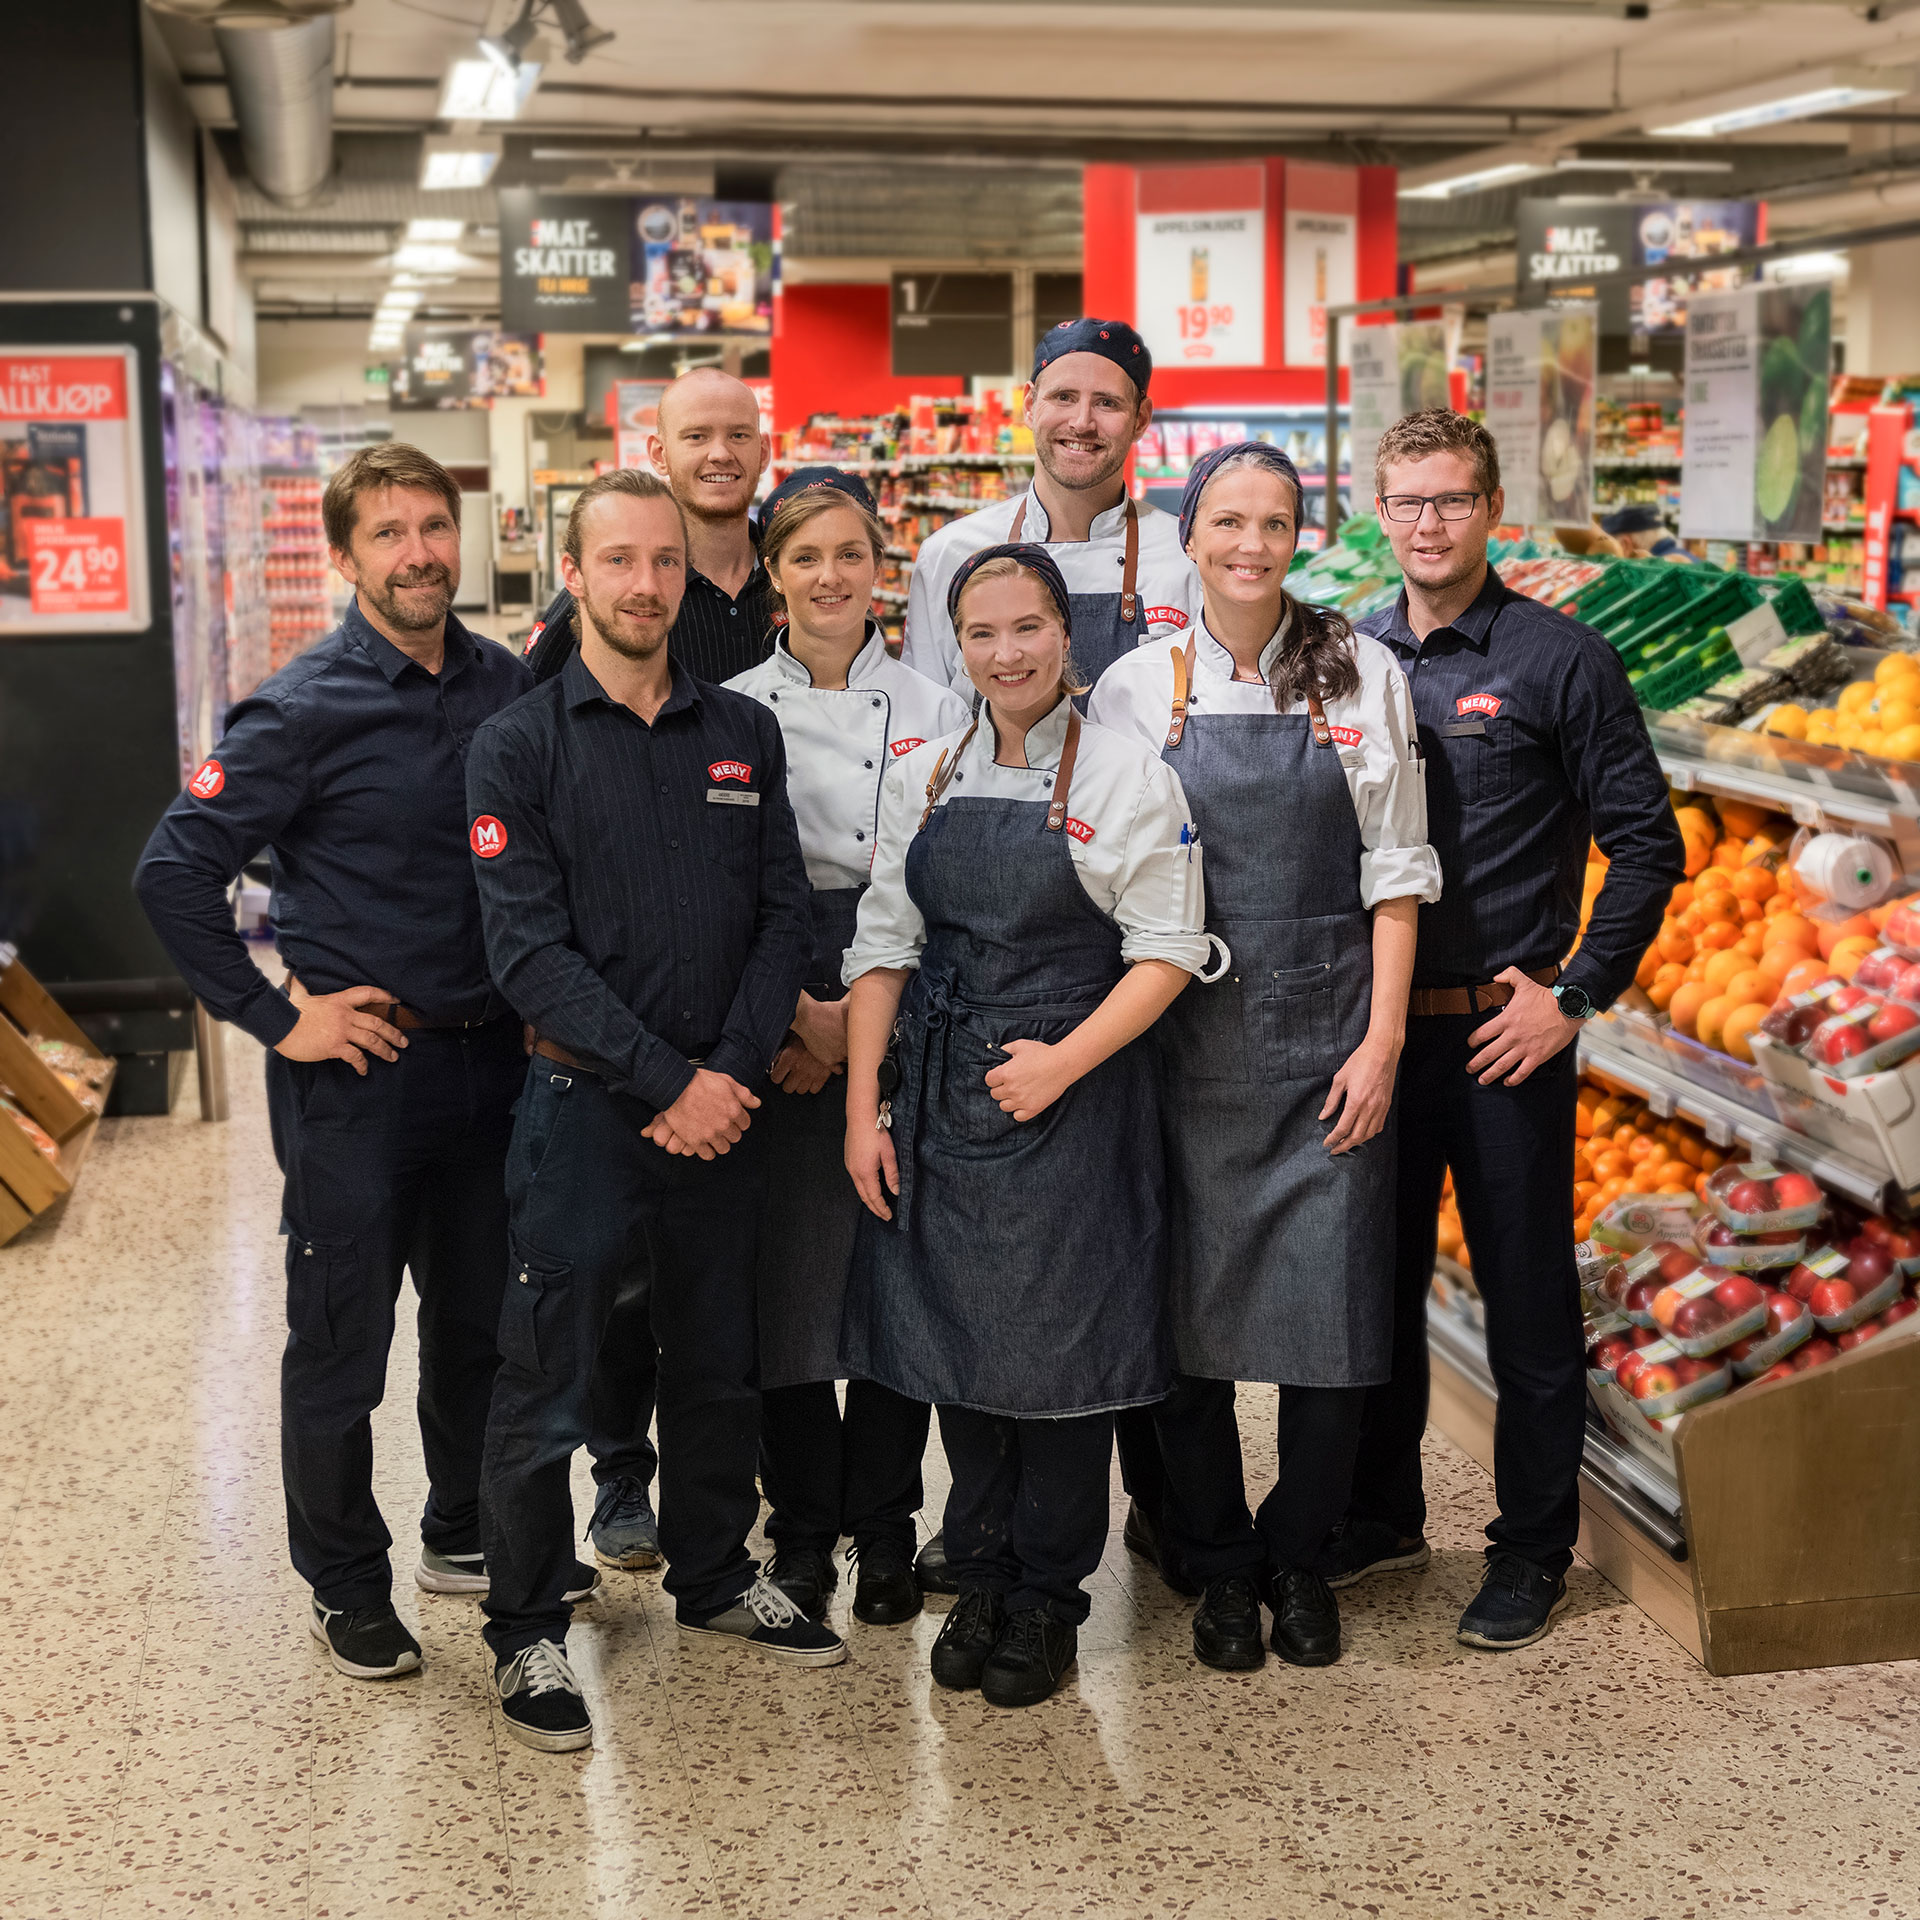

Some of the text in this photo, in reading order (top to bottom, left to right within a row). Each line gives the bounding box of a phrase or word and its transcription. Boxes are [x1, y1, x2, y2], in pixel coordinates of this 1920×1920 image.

[538, 219, 598, 248] MAT-
[514, 247, 617, 277] SKATTER
[900, 280, 917, 313] 1
[9, 364, 52, 384] FAST
[1145, 609, 1186, 624] MENY
[1462, 697, 1497, 711] MENY
[1330, 729, 1360, 742] ENY
[895, 740, 924, 752] ME
[196, 765, 220, 791] M
[712, 764, 747, 778] MENY
[476, 822, 500, 847] M
[1067, 820, 1093, 838] NY
